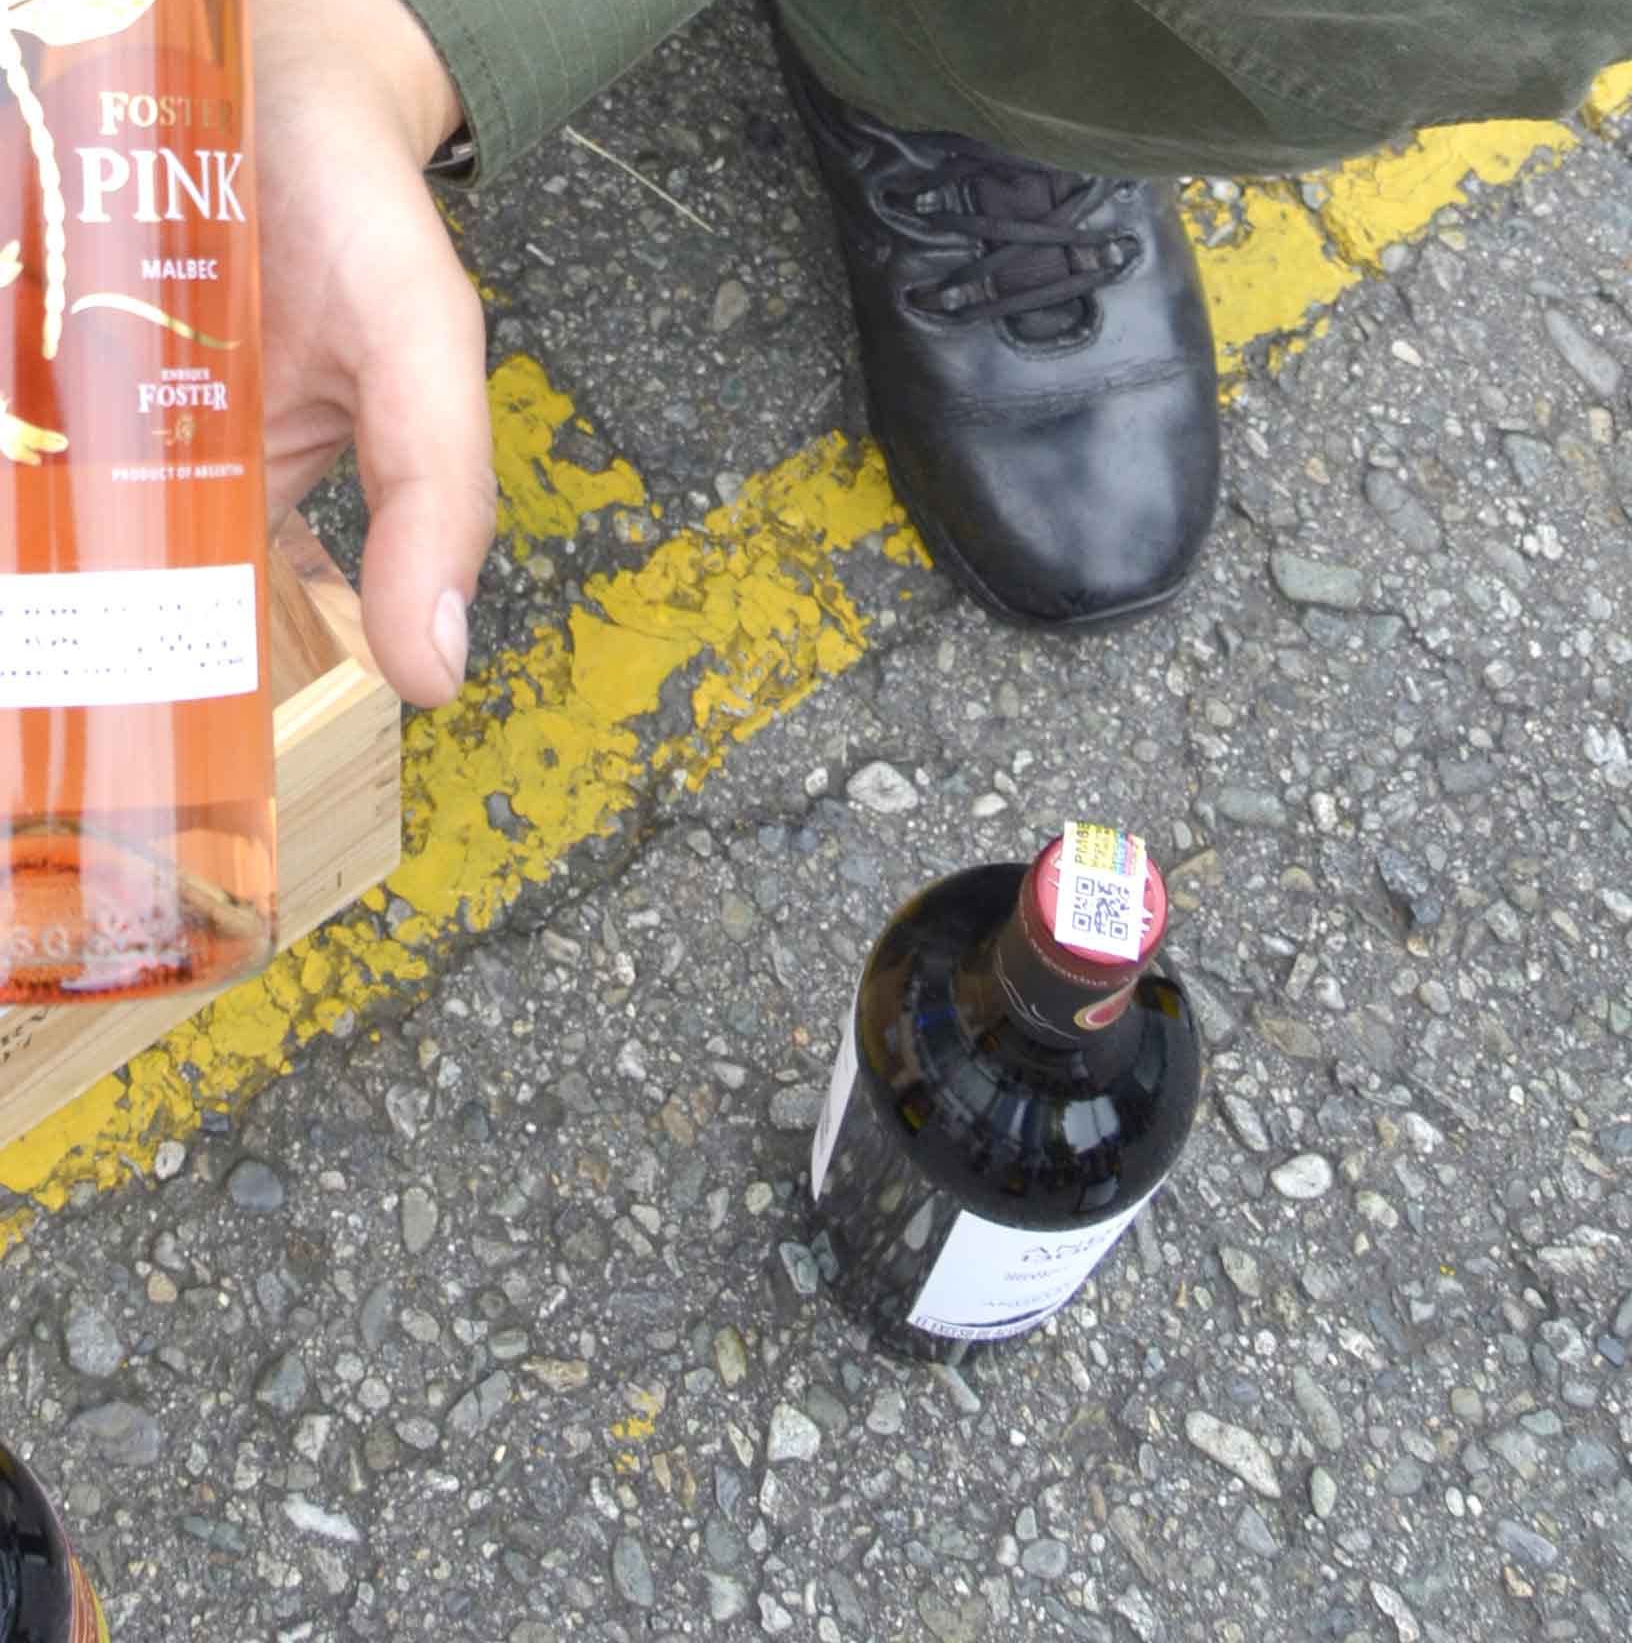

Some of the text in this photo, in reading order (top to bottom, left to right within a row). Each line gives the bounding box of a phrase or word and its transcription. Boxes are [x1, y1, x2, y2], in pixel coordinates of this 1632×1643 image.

[74, 146, 247, 224] PINK
[141, 258, 219, 282] MALBEC
[137, 381, 229, 414] FOSTER
